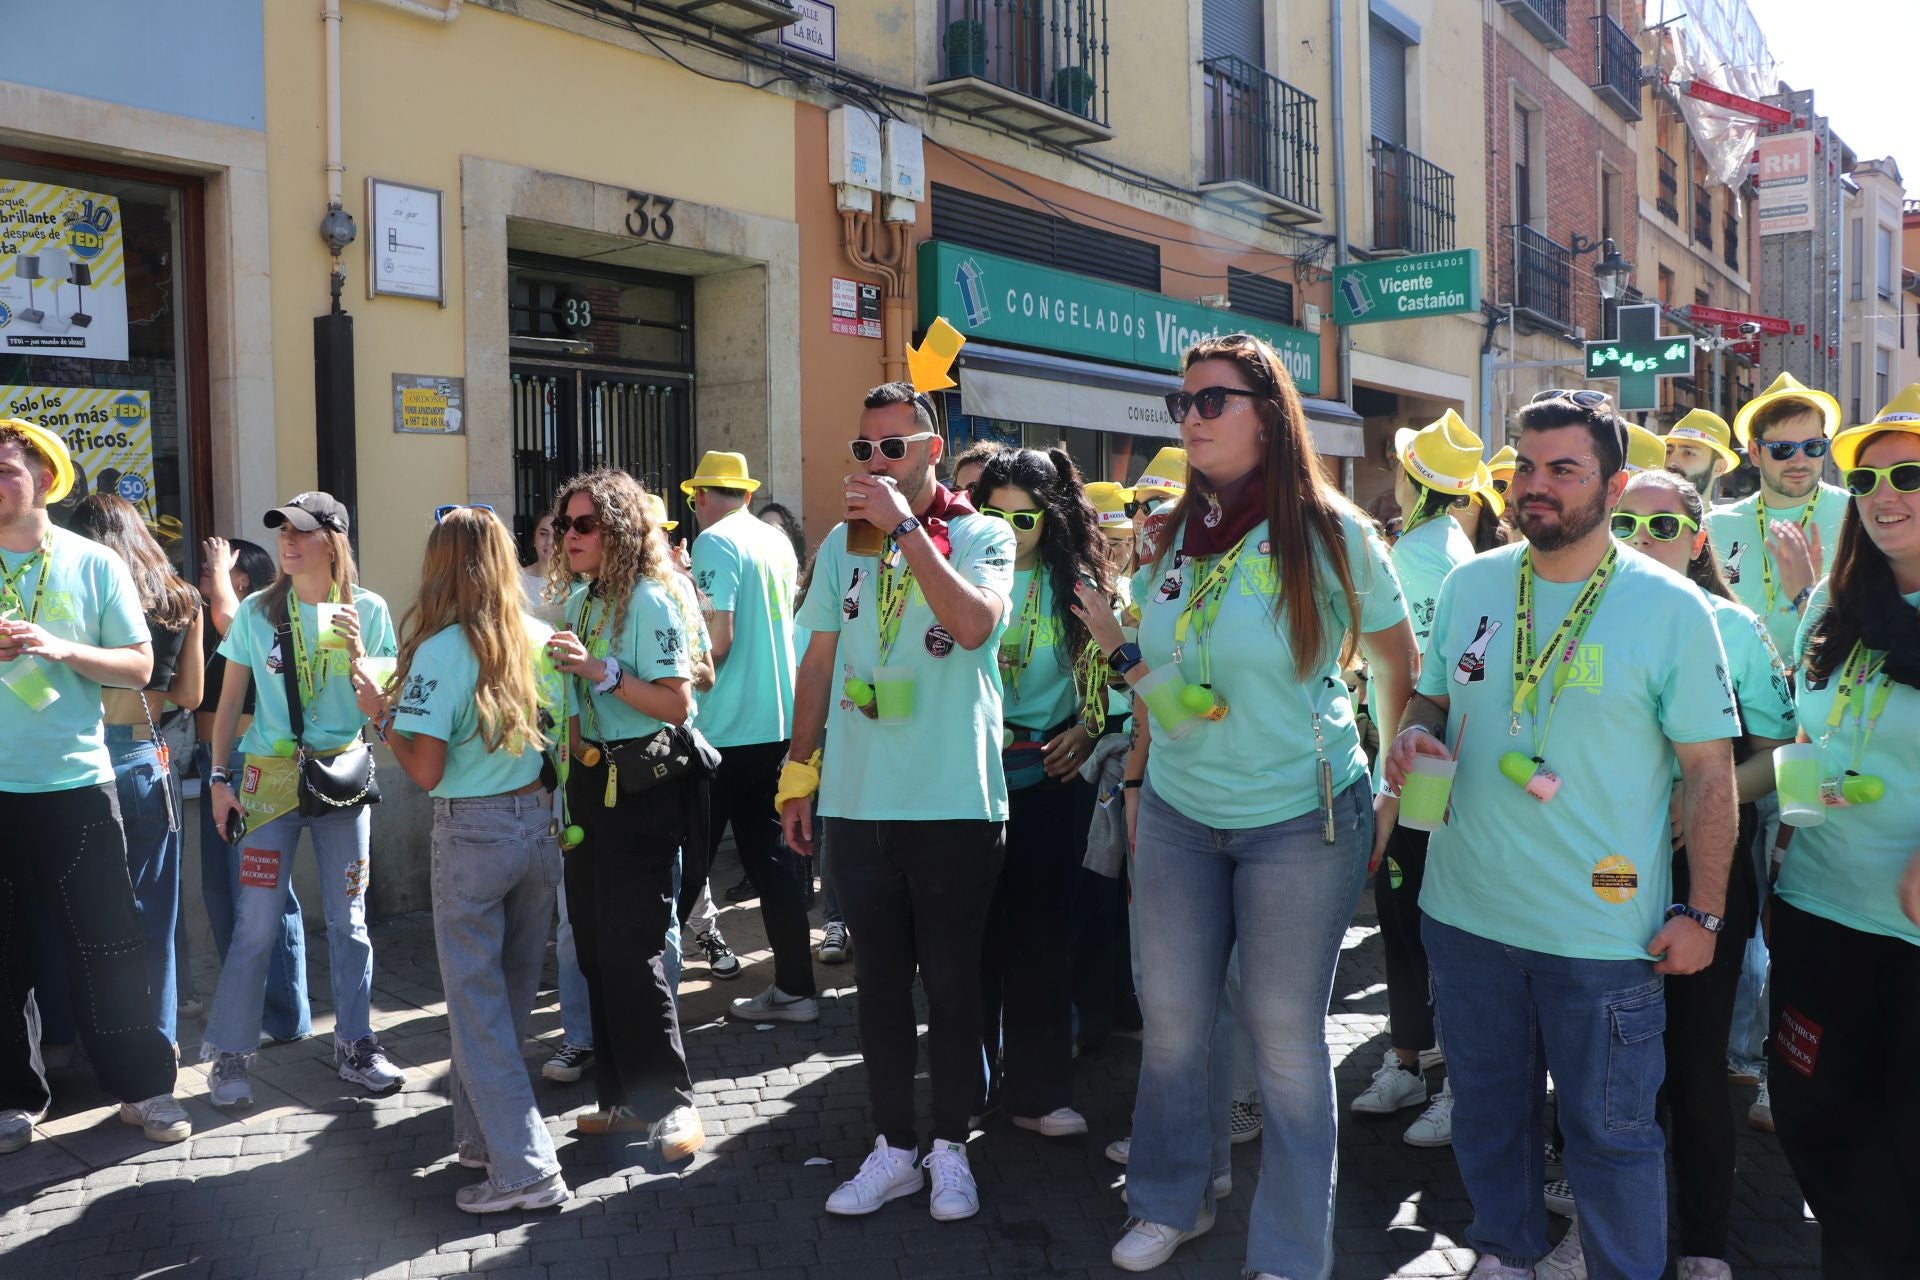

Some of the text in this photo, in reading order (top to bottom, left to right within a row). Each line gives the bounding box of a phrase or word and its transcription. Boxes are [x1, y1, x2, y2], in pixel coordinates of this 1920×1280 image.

[797, 4, 819, 22] CALLE
[793, 23, 824, 46] LA RÚA
[1764, 152, 1801, 174] RH
[0, 209, 57, 225] brillante
[81, 199, 113, 232] 10
[625, 190, 675, 241] 33
[3, 227, 61, 242] después de
[0, 241, 21, 255] ta.
[1395, 257, 1465, 273] CONGELADOS
[1378, 275, 1434, 296] Vicente
[1397, 290, 1465, 313] Castañón
[566, 299, 593, 328] 33
[1006, 290, 1147, 340] CONGELADOS
[10, 394, 62, 414] Solo los
[110, 403, 146, 419] TEDi
[39, 405, 109, 428] son más
[1128, 405, 1174, 426] CONGELADO
[63, 428, 134, 453] ríficos.
[121, 480, 144, 495] 30
